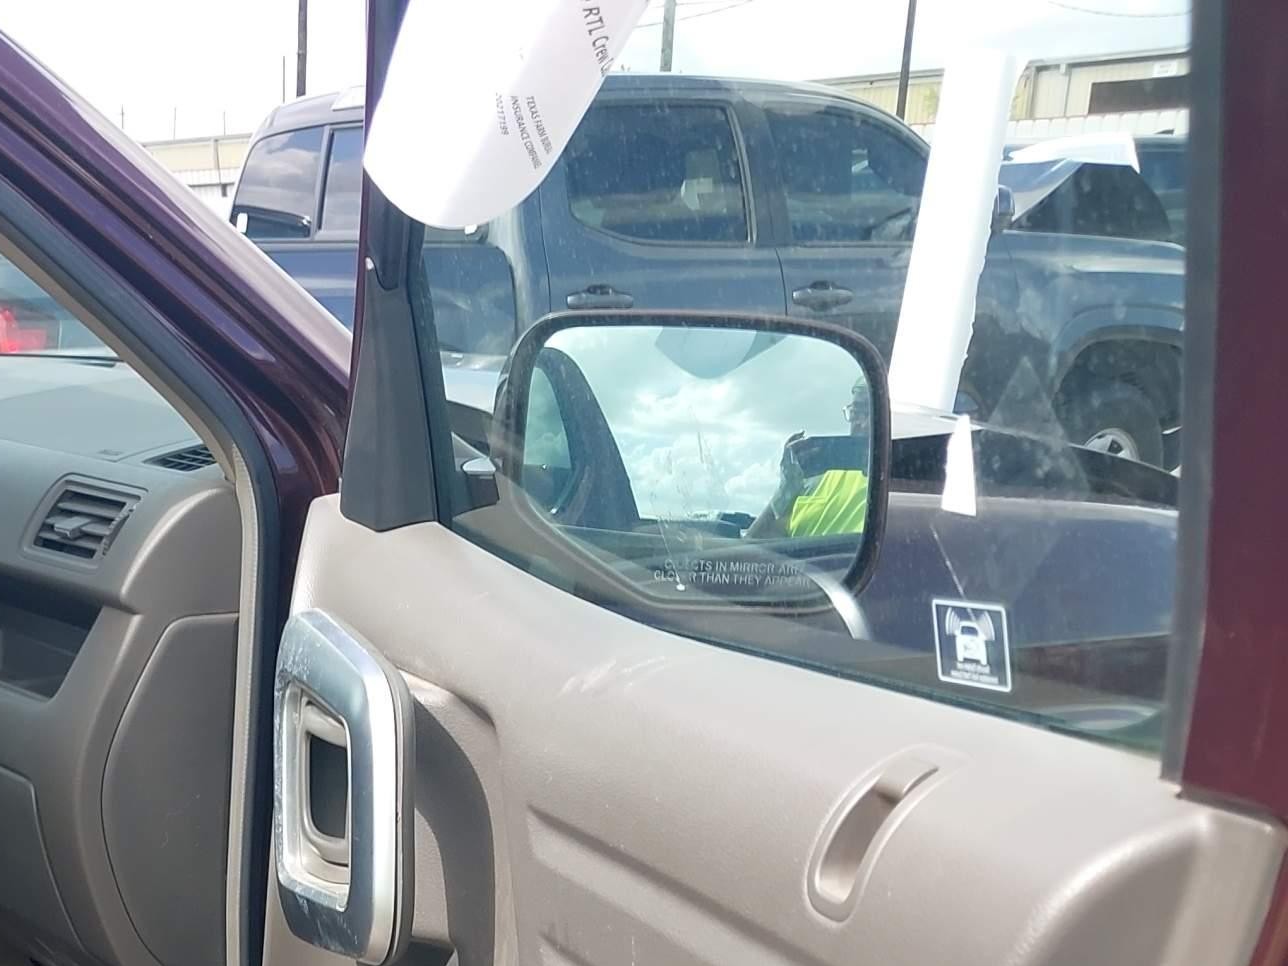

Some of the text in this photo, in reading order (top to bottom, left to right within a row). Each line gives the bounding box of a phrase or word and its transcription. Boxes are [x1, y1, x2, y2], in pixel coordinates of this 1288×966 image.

[582, 7, 605, 36] RTL
[592, 36, 609, 64] Crew
[510, 95, 530, 141] INSURANCE
[526, 95, 541, 120] TEXAS
[700, 571, 730, 584] THAN
[734, 573, 761, 586] THEY
[715, 560, 727, 572] IN
[730, 561, 775, 574] MIRROR
